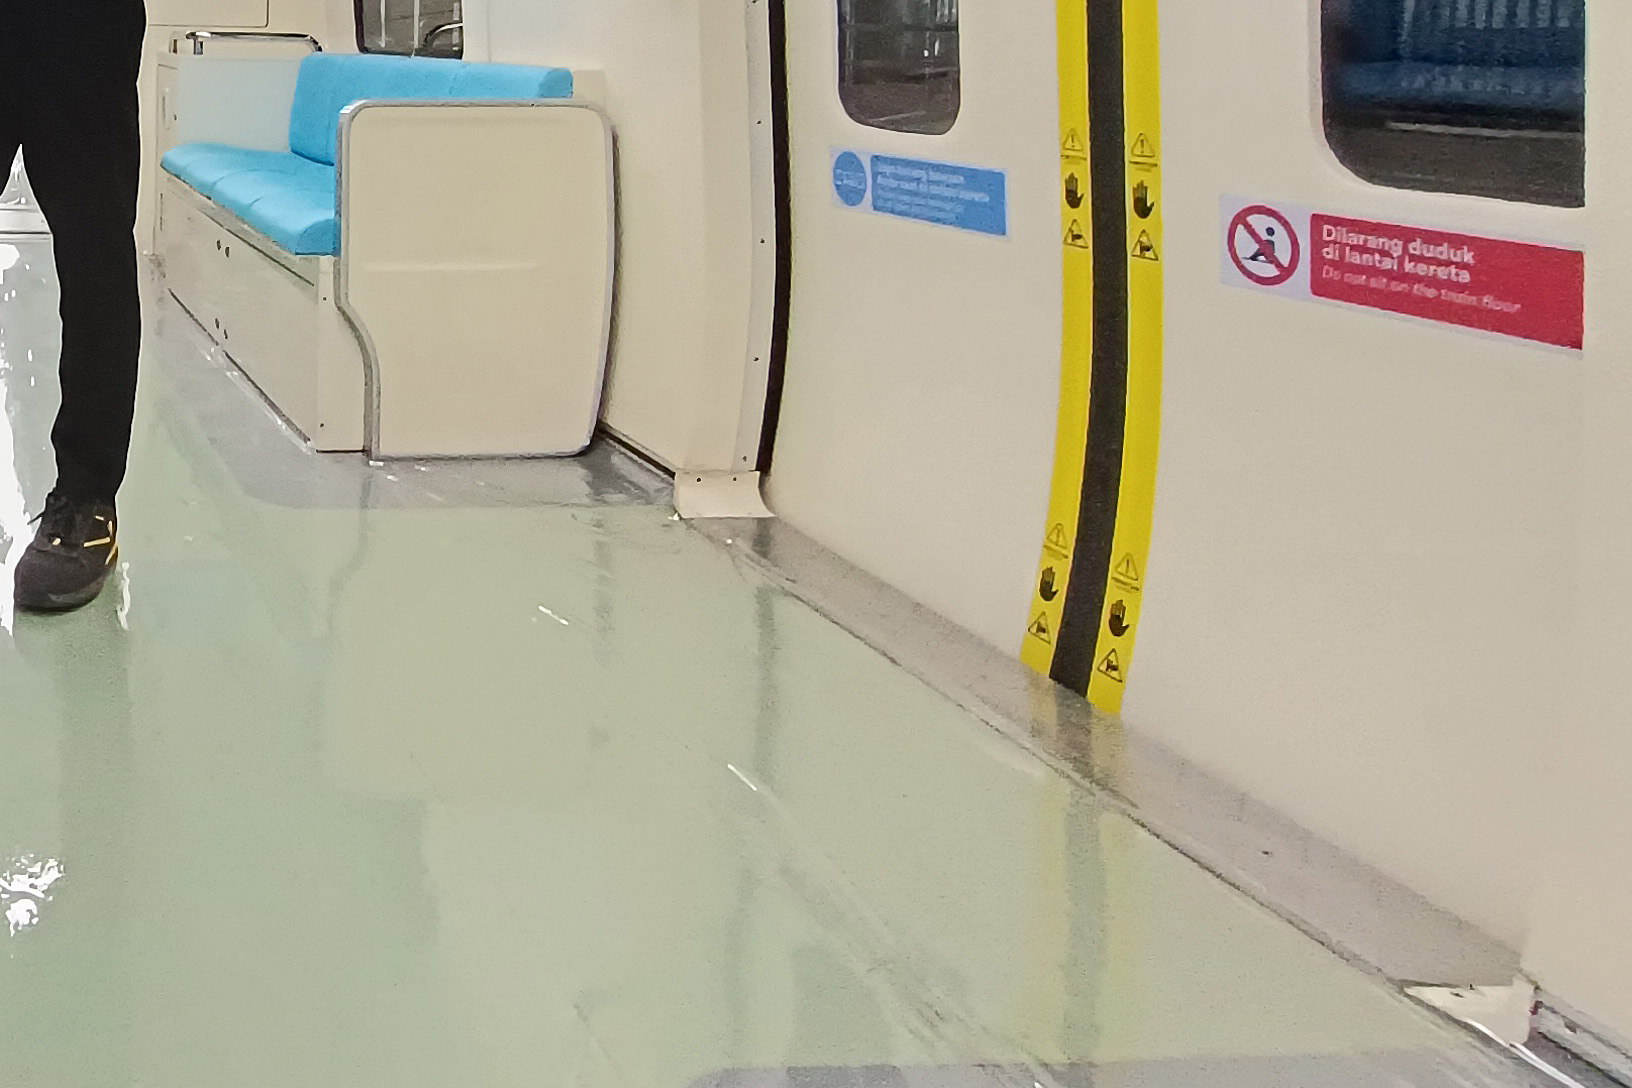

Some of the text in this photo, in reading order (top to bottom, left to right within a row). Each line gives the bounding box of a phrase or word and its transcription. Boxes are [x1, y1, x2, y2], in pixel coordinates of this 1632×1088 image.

[1321, 224, 1475, 266] Dilarang duduk
[1321, 243, 1471, 283] di lantai kereta
